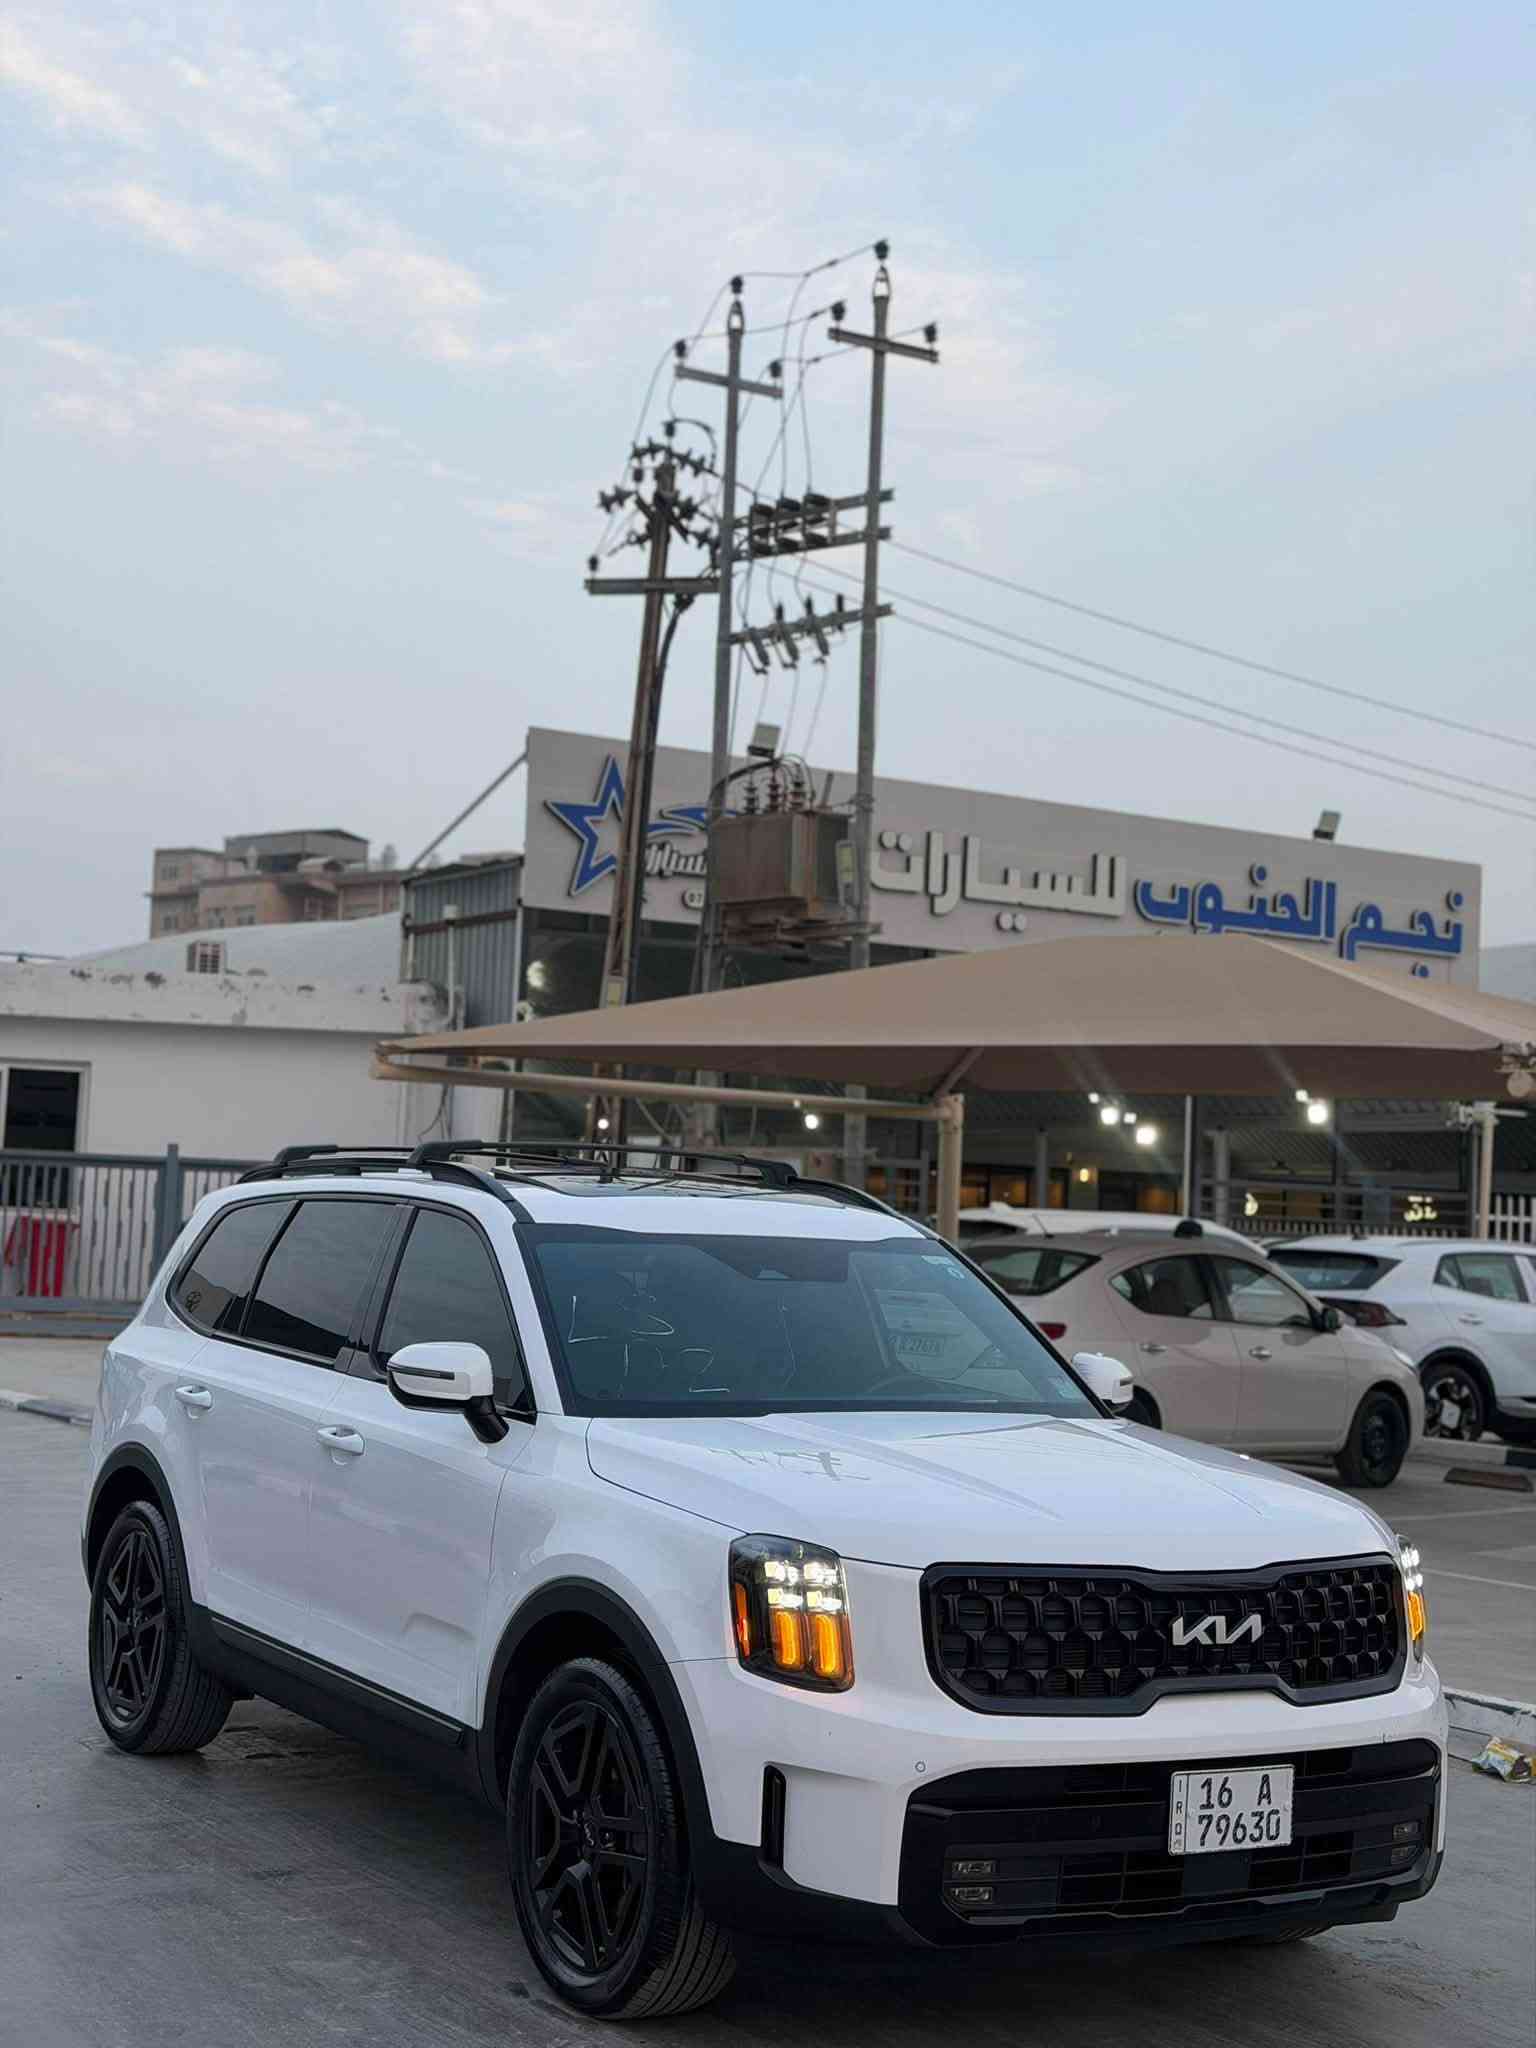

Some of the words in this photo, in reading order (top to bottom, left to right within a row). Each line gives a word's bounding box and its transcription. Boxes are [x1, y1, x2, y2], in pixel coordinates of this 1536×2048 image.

[870, 831, 1127, 933] للسيارات
[1135, 863, 1338, 945] الجنوب
[1339, 890, 1465, 979] نجم
[1171, 1613, 1263, 1646] KIA
[1199, 1776, 1233, 1809] 16
[1257, 1774, 1272, 1806] A
[1198, 1809, 1281, 1847] 79630
